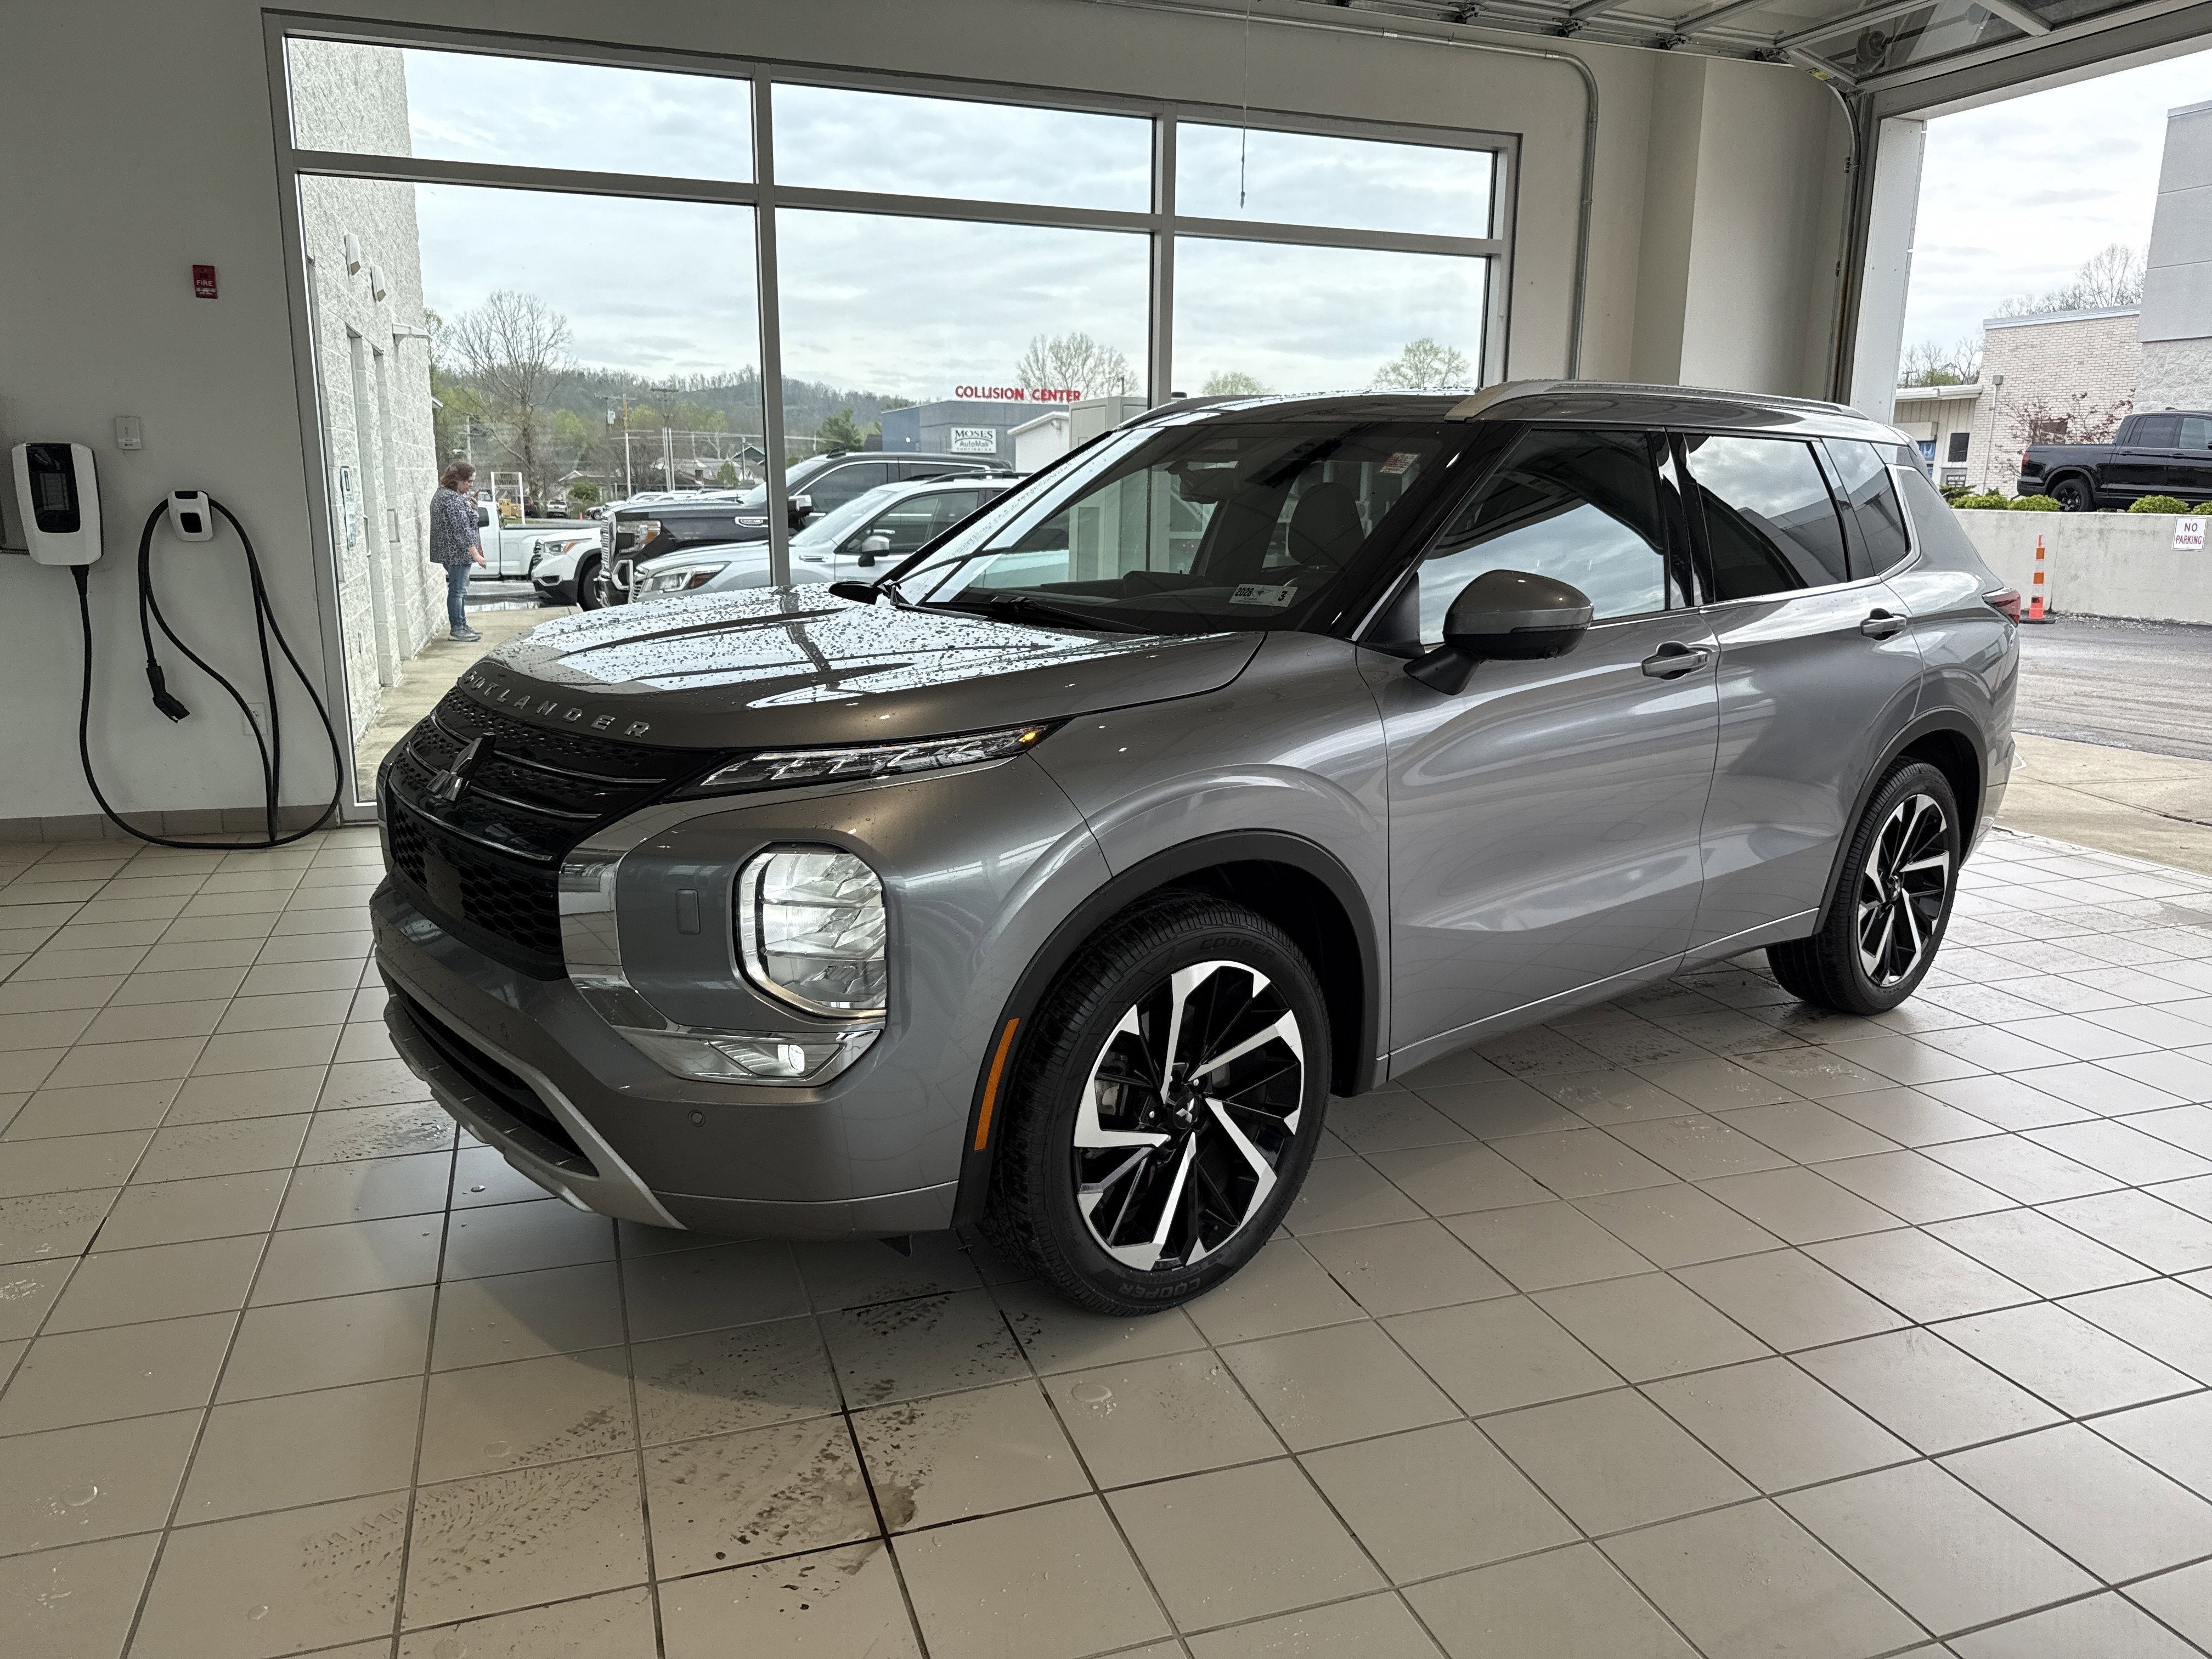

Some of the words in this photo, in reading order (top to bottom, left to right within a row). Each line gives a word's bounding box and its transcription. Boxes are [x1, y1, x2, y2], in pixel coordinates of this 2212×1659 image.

[955, 385, 1025, 400] COLLISION
[1031, 388, 1081, 402] CENTER
[955, 430, 993, 439] MOSES
[2184, 522, 2198, 532] NO
[2175, 535, 2203, 545] PARKING
[1234, 587, 1255, 597] 2028
[1277, 590, 1288, 602] 3
[1199, 936, 1277, 959] COOPER
[1119, 1277, 1201, 1299] COOPER
